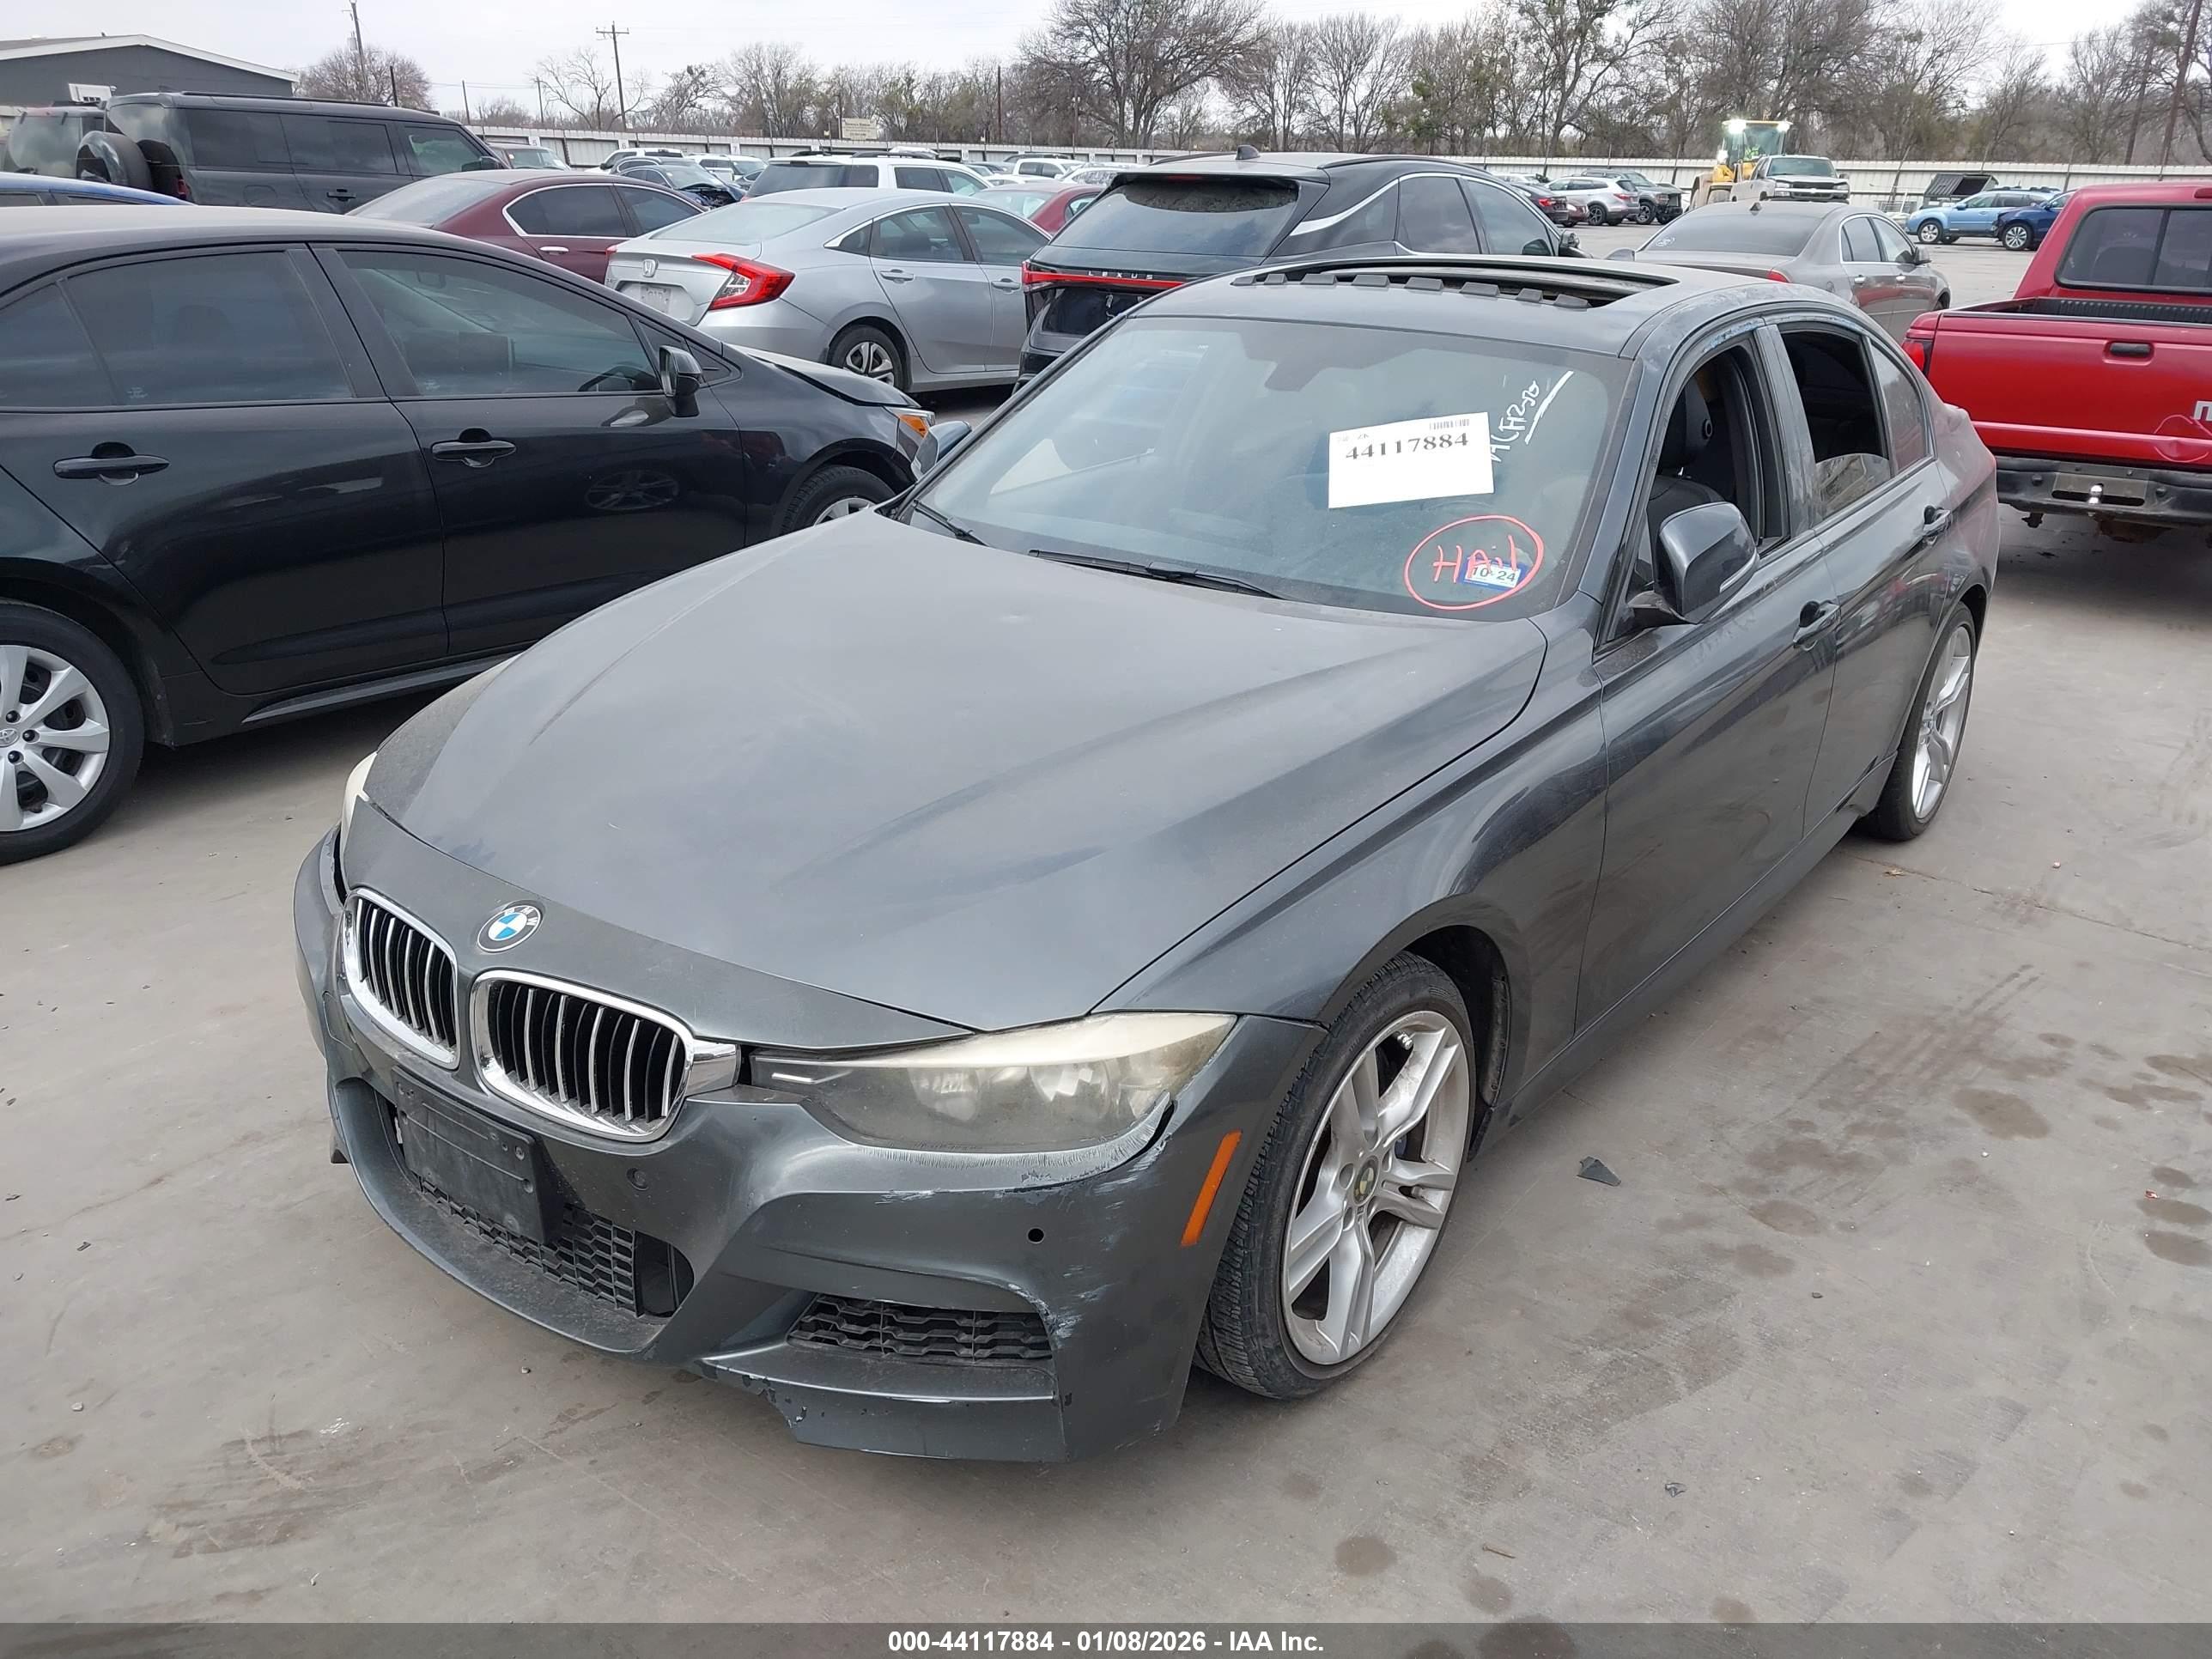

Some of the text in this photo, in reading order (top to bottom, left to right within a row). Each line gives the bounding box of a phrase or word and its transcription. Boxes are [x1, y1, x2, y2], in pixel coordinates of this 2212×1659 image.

[1088, 270, 1153, 280] LEXUS
[1346, 432, 1469, 460] 44117884
[1497, 570, 1516, 582] 24
